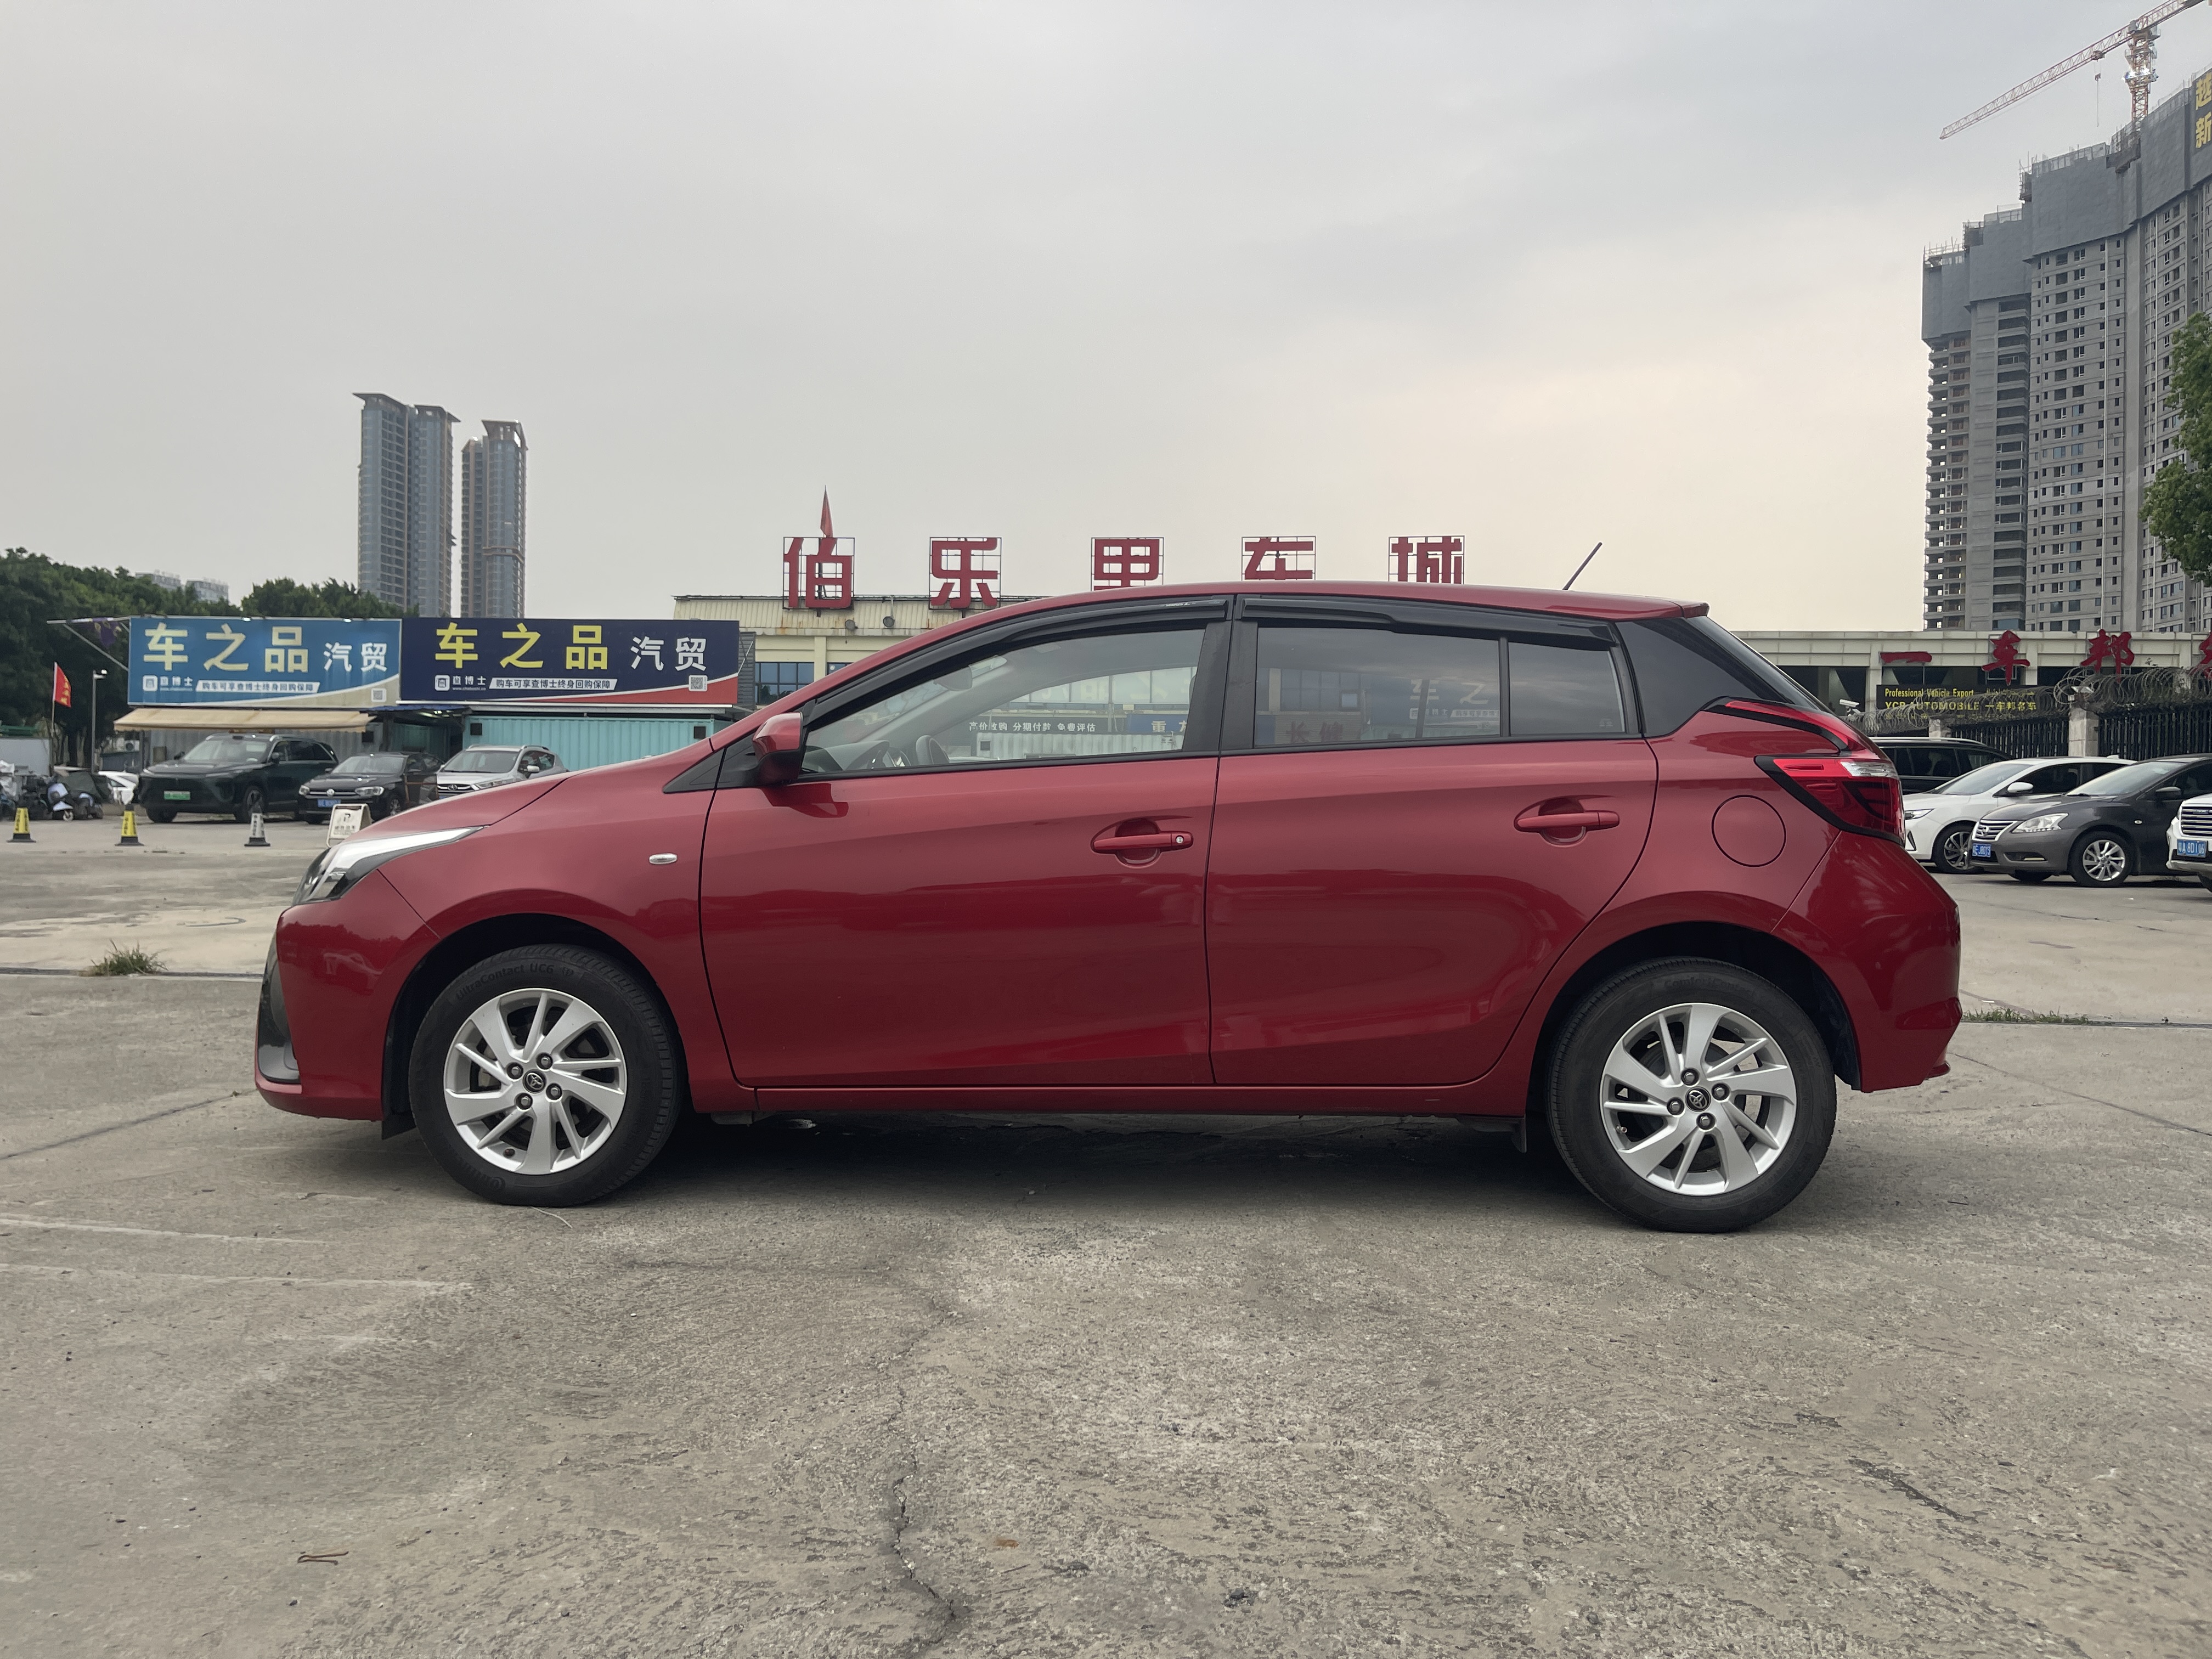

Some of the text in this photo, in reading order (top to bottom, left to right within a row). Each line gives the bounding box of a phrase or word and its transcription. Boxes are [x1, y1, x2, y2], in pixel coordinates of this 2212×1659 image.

[143, 622, 388, 673] 车之品 汽贸
[435, 622, 707, 671] 车之品 汽贸
[496, 679, 611, 690] 购车可享查博士终身回购保障
[1885, 688, 1974, 698] Professional Vehicle Export
[969, 721, 1096, 732] 高价收购 分期付款 免费评估
[454, 963, 554, 1002] UltraContact UC6
